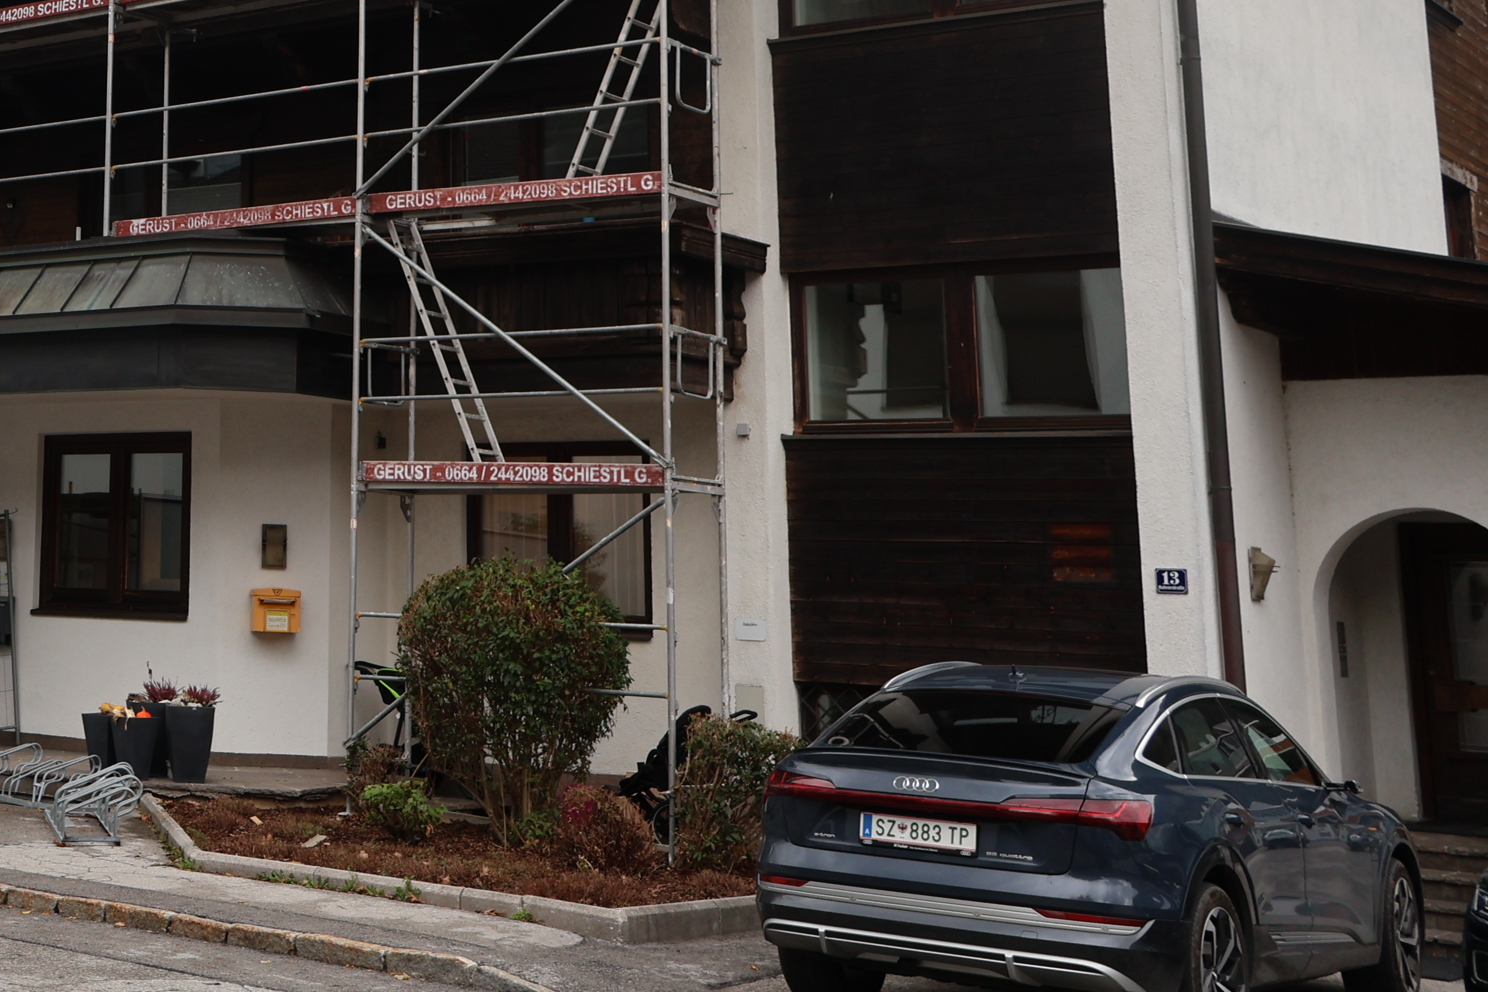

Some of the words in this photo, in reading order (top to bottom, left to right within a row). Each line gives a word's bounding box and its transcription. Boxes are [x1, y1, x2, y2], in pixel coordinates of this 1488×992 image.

[445, 466, 477, 480] 0664
[490, 466, 548, 481] 2442098
[552, 467, 629, 482] SCHIESTL
[634, 468, 651, 482] G.
[1161, 571, 1180, 585] 13
[875, 818, 896, 838] SZ
[909, 822, 942, 843] 883
[948, 826, 970, 845] TP
